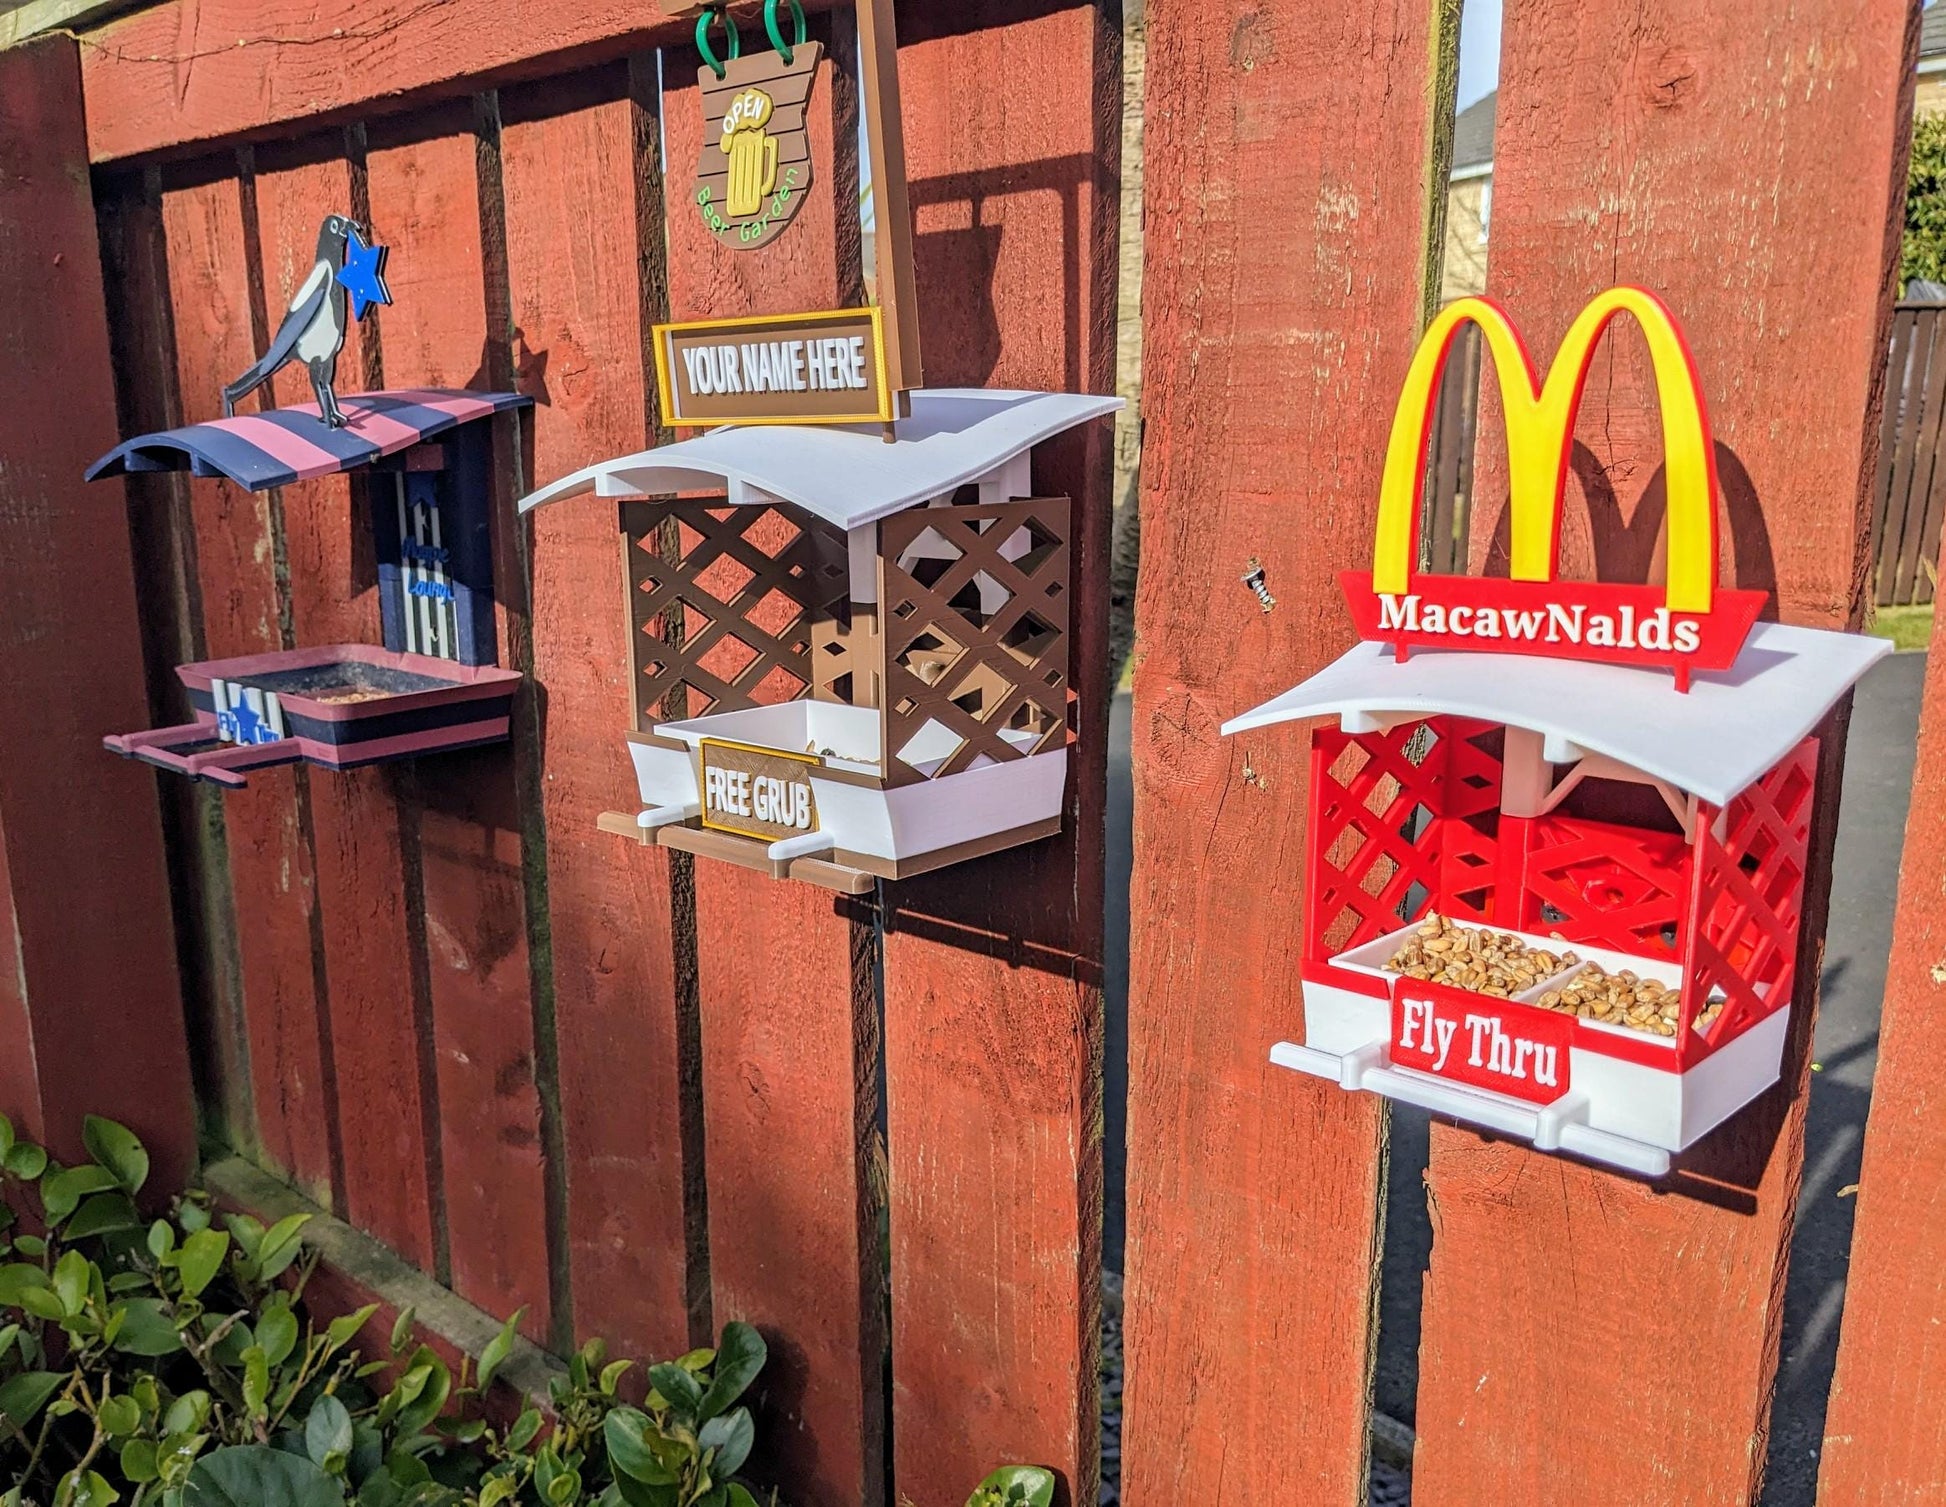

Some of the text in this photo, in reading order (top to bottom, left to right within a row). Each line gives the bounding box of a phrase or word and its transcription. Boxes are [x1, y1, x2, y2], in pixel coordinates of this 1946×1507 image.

[723, 94, 764, 134] OPEN
[697, 168, 798, 242] Beer Garden
[682, 336, 869, 394] YOUR NAME HERE
[1377, 593, 1700, 652] MacawNalds
[706, 766, 812, 829] FREE GRUB
[1400, 998, 1558, 1087] Fly Thru
